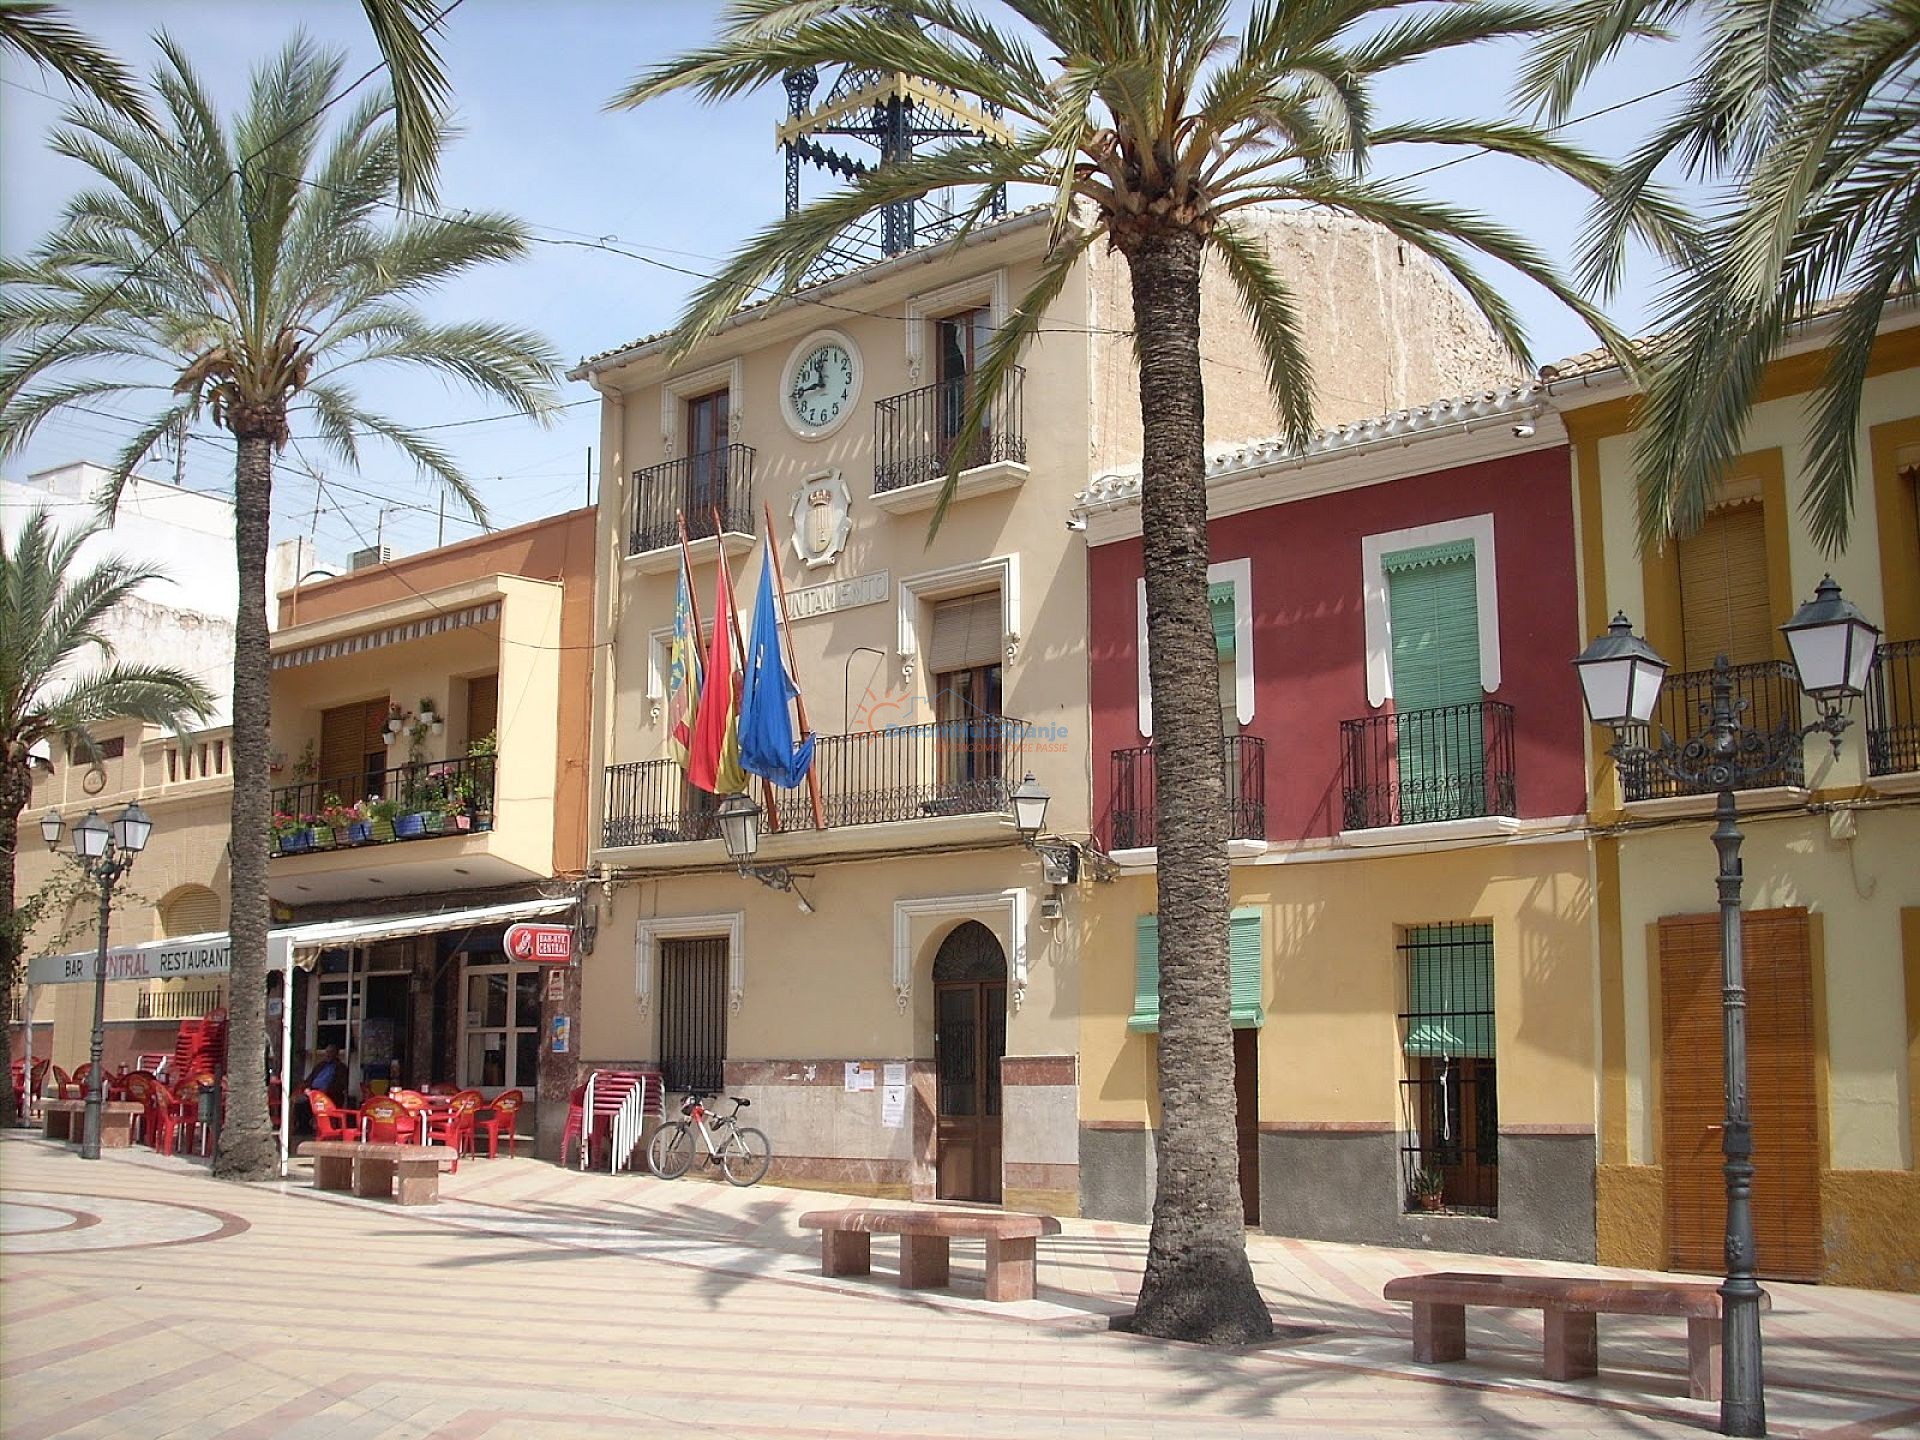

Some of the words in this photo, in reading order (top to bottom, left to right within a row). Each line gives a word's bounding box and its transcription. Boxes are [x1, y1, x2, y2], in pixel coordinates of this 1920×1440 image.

[841, 358, 848, 371] 2
[802, 371, 810, 383] 10
[845, 372, 852, 384] 3
[841, 388, 848, 400] 4
[801, 400, 808, 413] 8
[832, 402, 839, 414] 5
[810, 408, 816, 420] 7
[821, 409, 827, 421] 6
[539, 943, 567, 954] CENTRAL
[65, 959, 84, 977] BAR
[94, 953, 149, 977] CNTRAL
[160, 947, 231, 971] RESTAURANT
